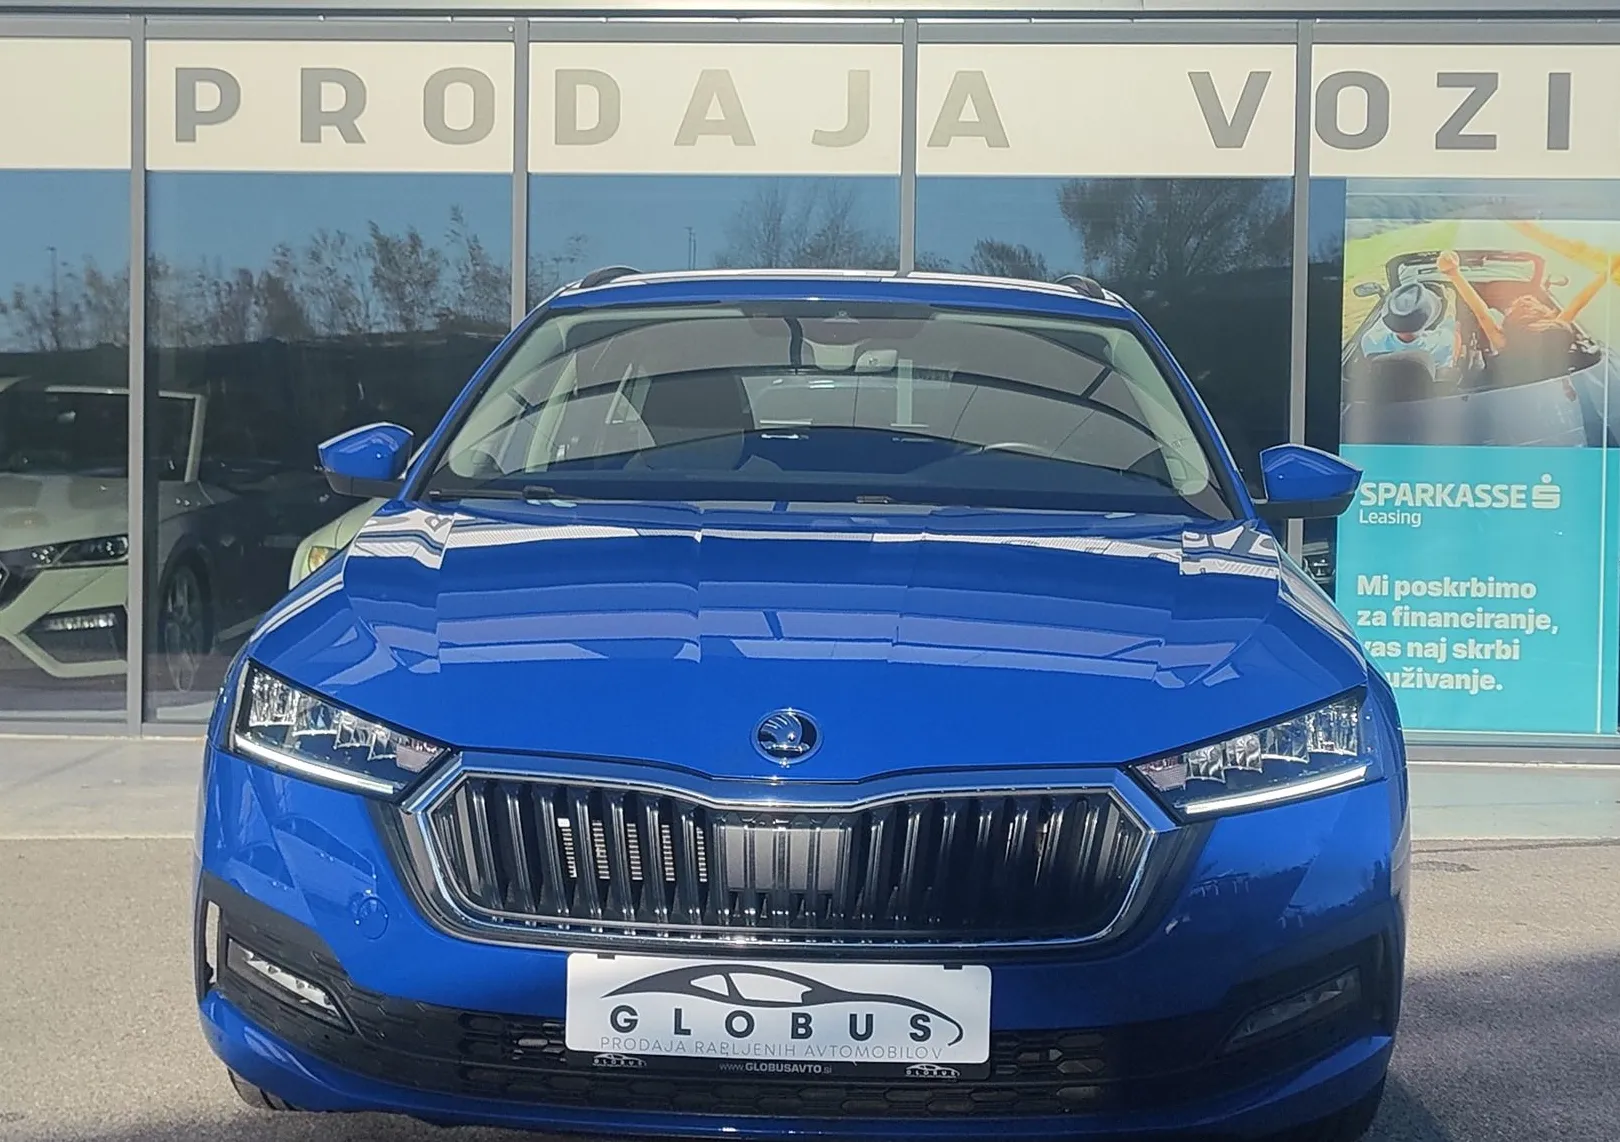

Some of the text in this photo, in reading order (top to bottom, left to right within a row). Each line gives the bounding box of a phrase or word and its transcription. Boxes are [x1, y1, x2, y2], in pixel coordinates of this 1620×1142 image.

[174, 66, 1572, 151] PRODAJA VOZI
[1359, 482, 1528, 509] SPARKASSE
[1358, 509, 1422, 528] Leasing
[1356, 574, 1537, 601] Mi poskrbimo
[1356, 605, 1559, 635] za financiranje,
[1406, 636, 1448, 664] naj
[1452, 638, 1521, 661] skrbi
[1385, 666, 1503, 695] uživanje.
[609, 1003, 933, 1042] GLOBUS
[600, 1036, 687, 1054] PRODAJA
[803, 1044, 943, 1060] AVTOMOBILOV
